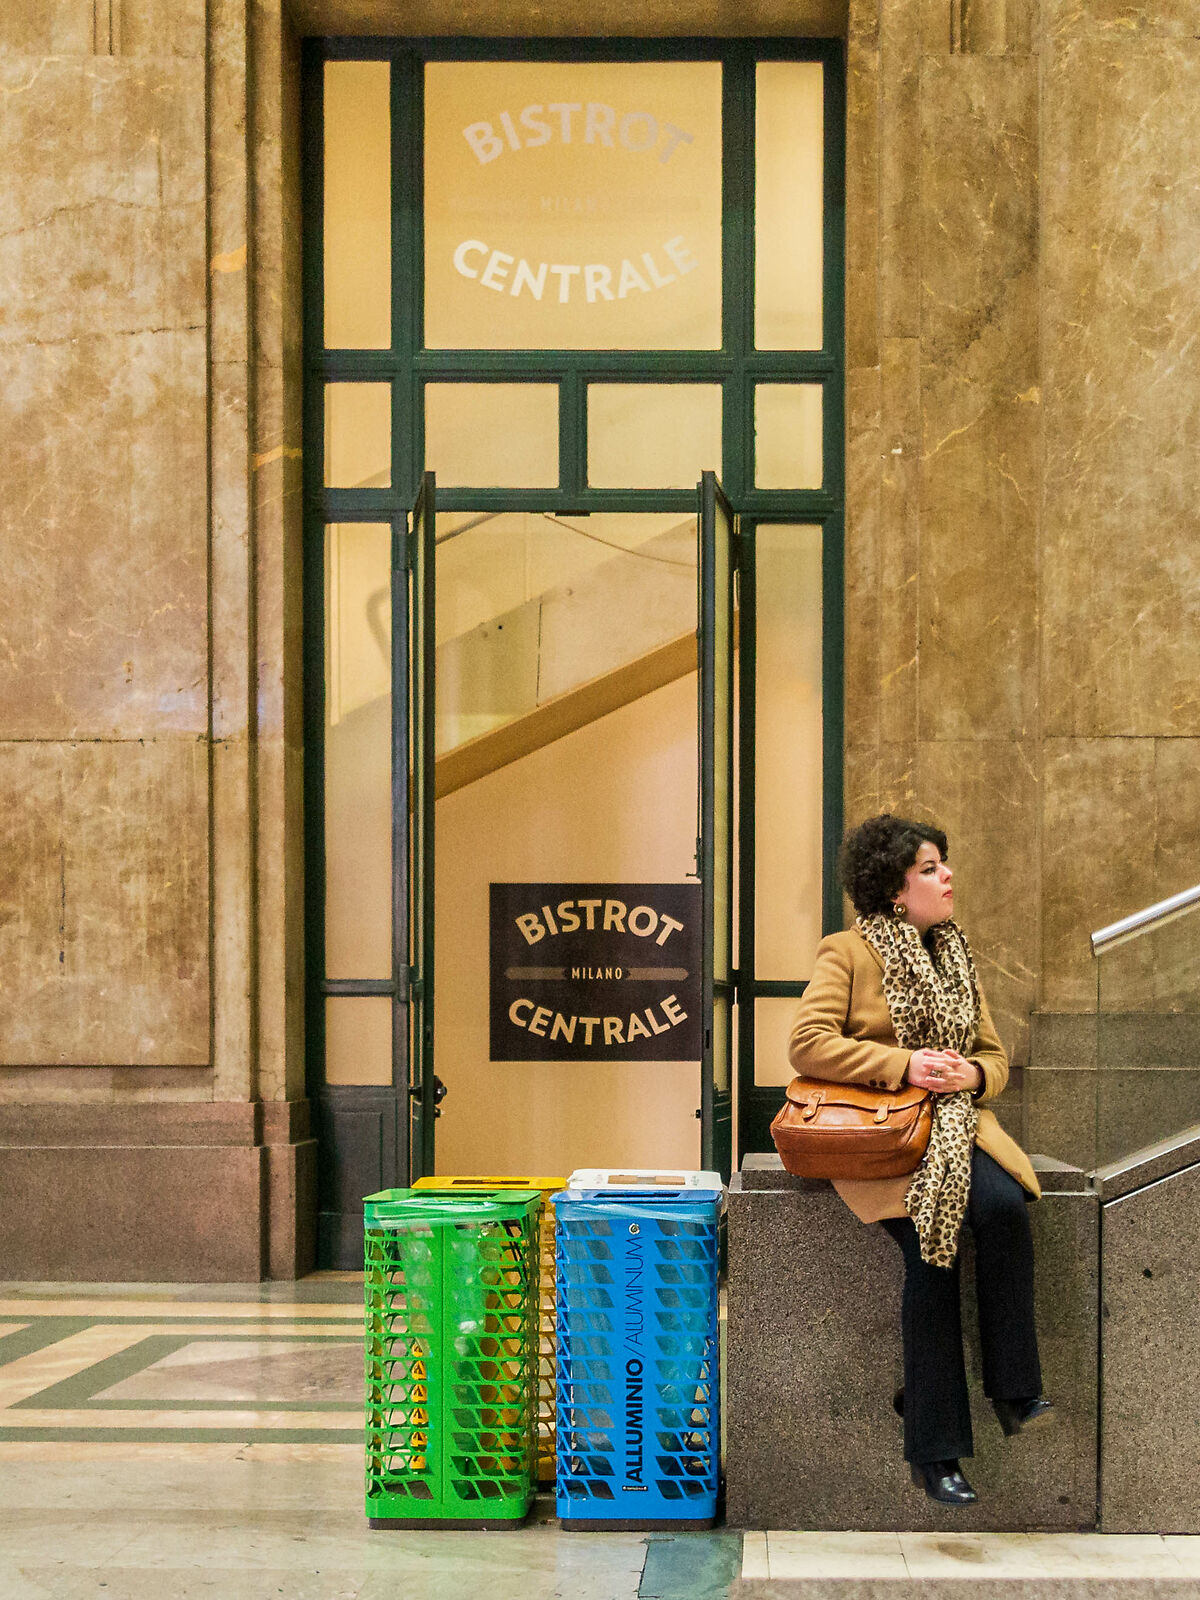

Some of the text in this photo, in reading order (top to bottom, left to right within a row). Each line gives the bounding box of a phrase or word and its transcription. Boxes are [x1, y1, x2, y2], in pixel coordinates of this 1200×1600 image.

[462, 102, 695, 165] BISTROT
[540, 196, 610, 212] MILAN
[452, 235, 699, 304] CENTRALE
[515, 898, 685, 947] BISTROT
[571, 967, 623, 980] MILANO
[508, 994, 688, 1046] CENTRALE
